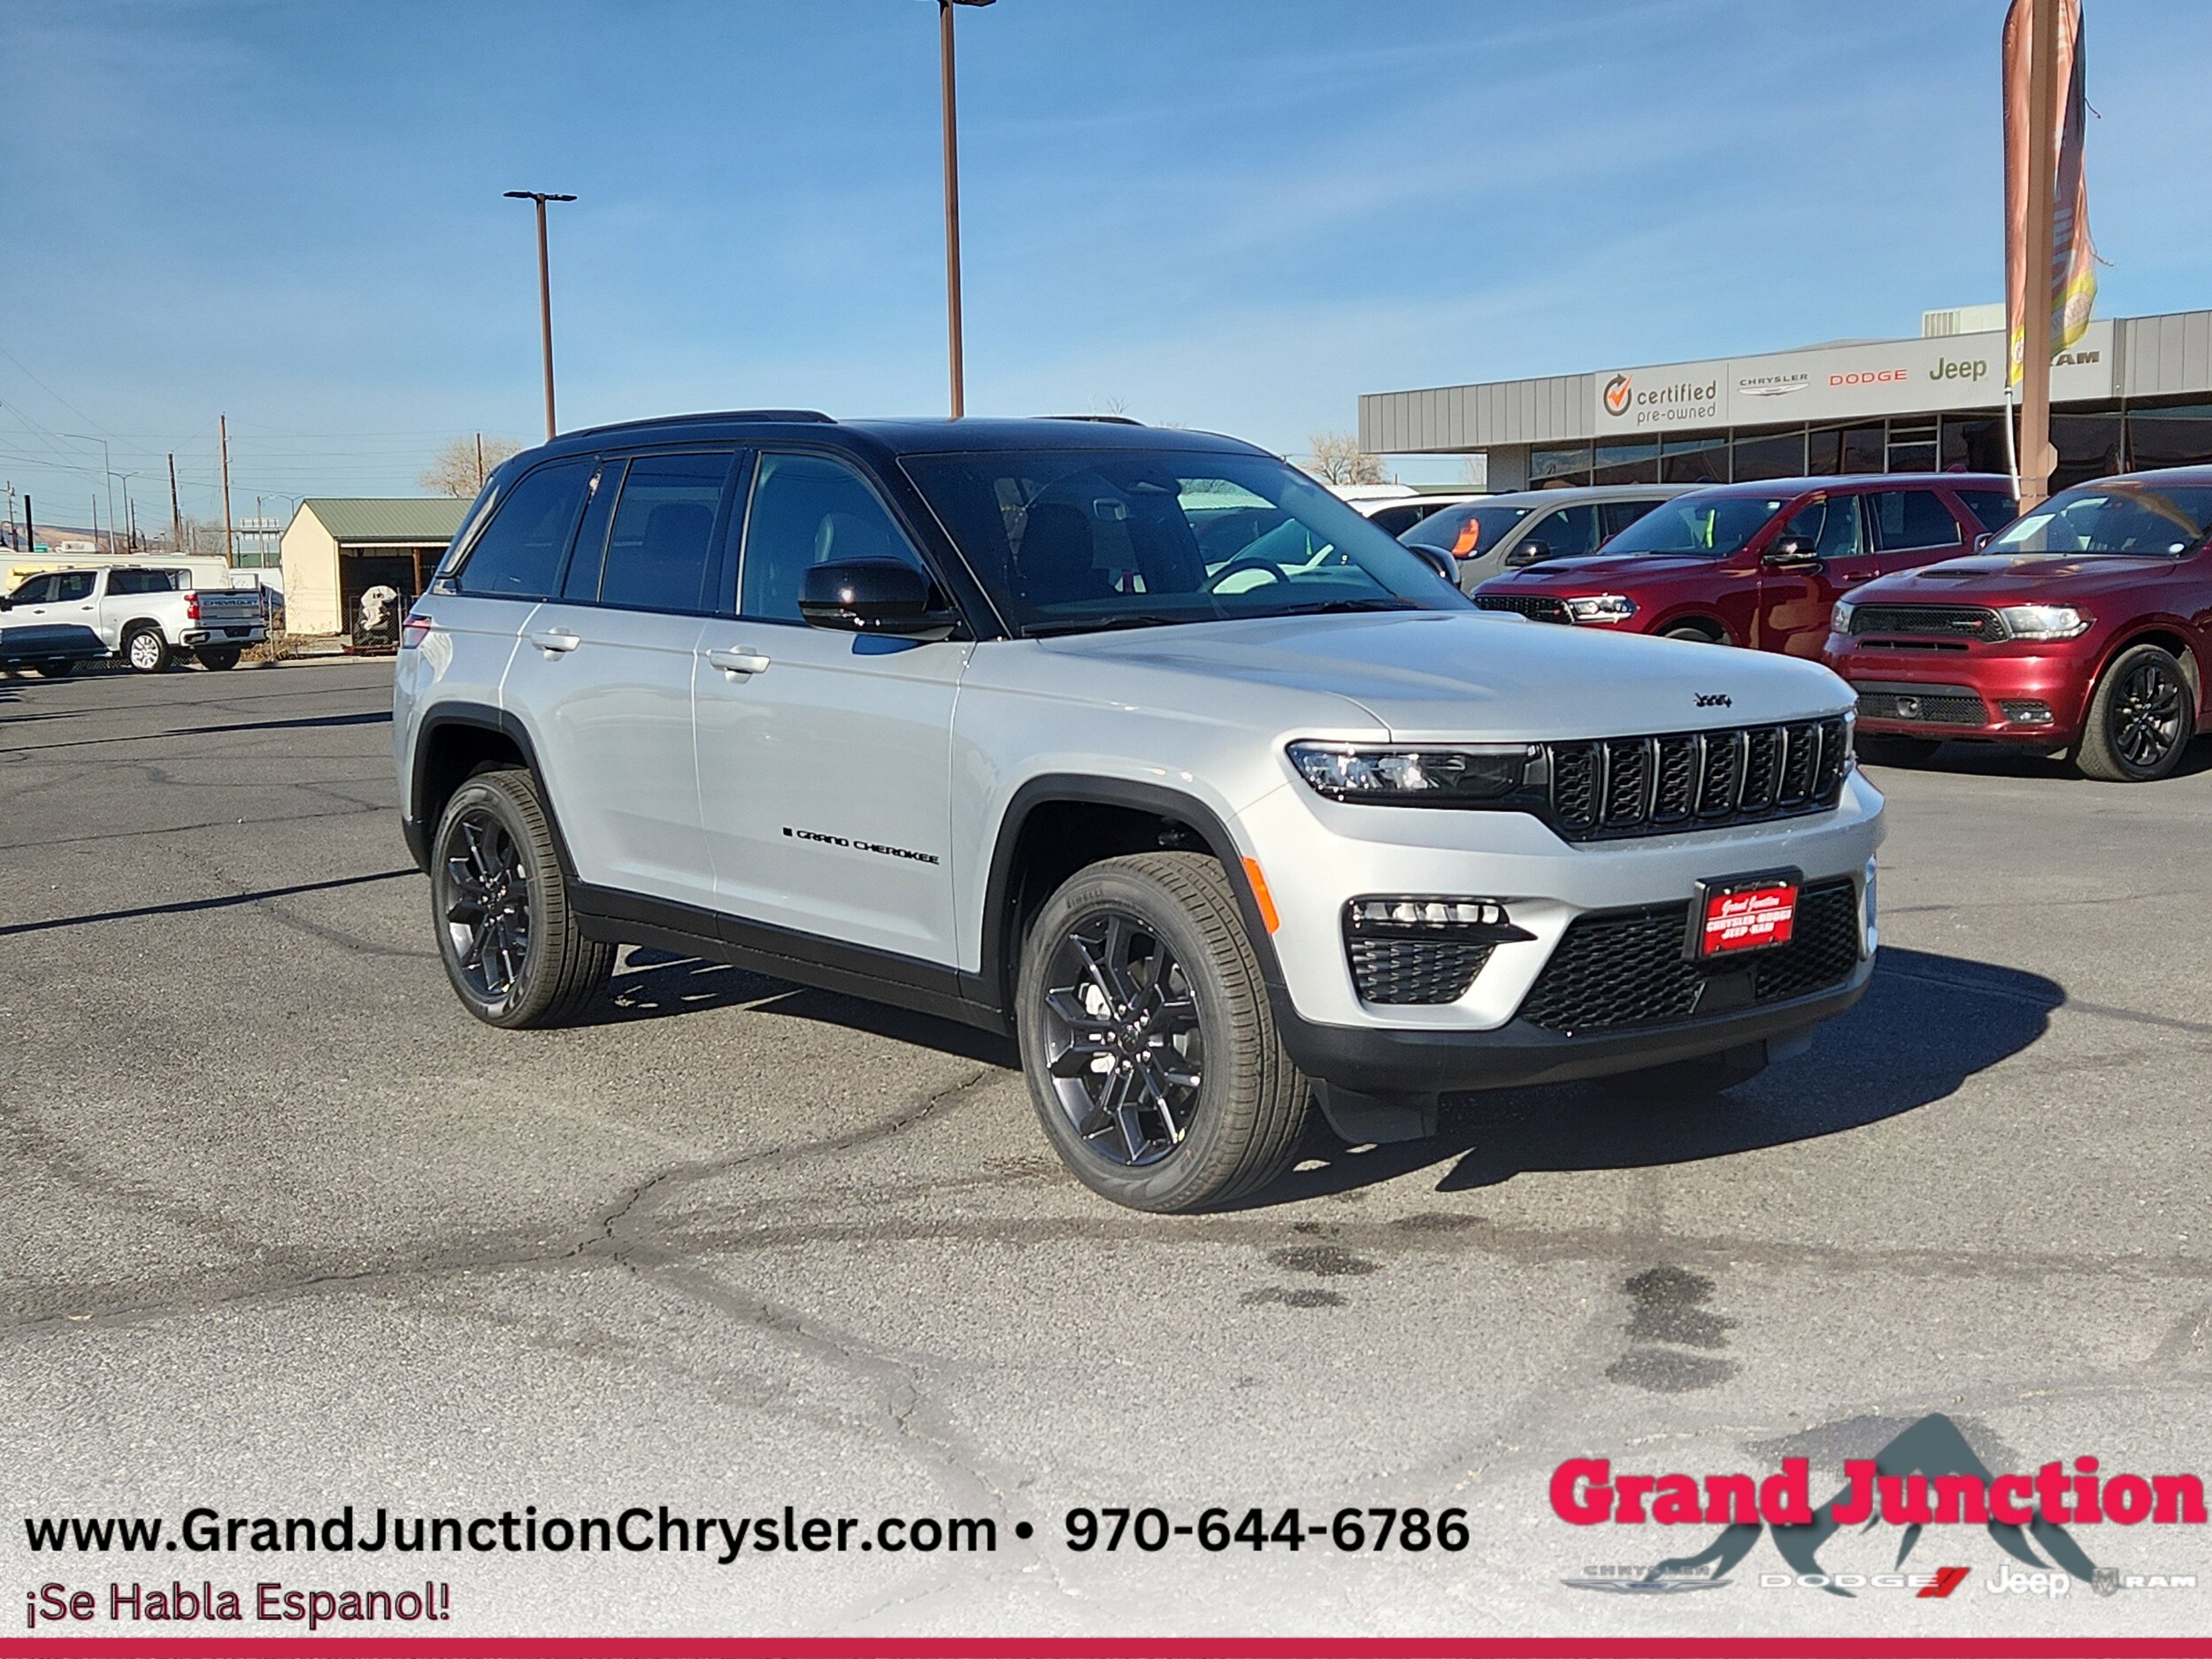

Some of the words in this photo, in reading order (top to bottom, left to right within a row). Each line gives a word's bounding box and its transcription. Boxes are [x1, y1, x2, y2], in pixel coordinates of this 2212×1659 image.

[2050, 351, 2100, 366] AM
[1829, 369, 1908, 386] DODGE
[1929, 357, 1987, 381] Jeep
[1740, 373, 1809, 386] CHRYSLER
[1637, 380, 1717, 405] certified
[1637, 403, 1717, 426] pre-owned
[1694, 692, 1732, 708] Jeep
[796, 830, 849, 847] GRAND
[853, 841, 940, 865] CHEROKEE
